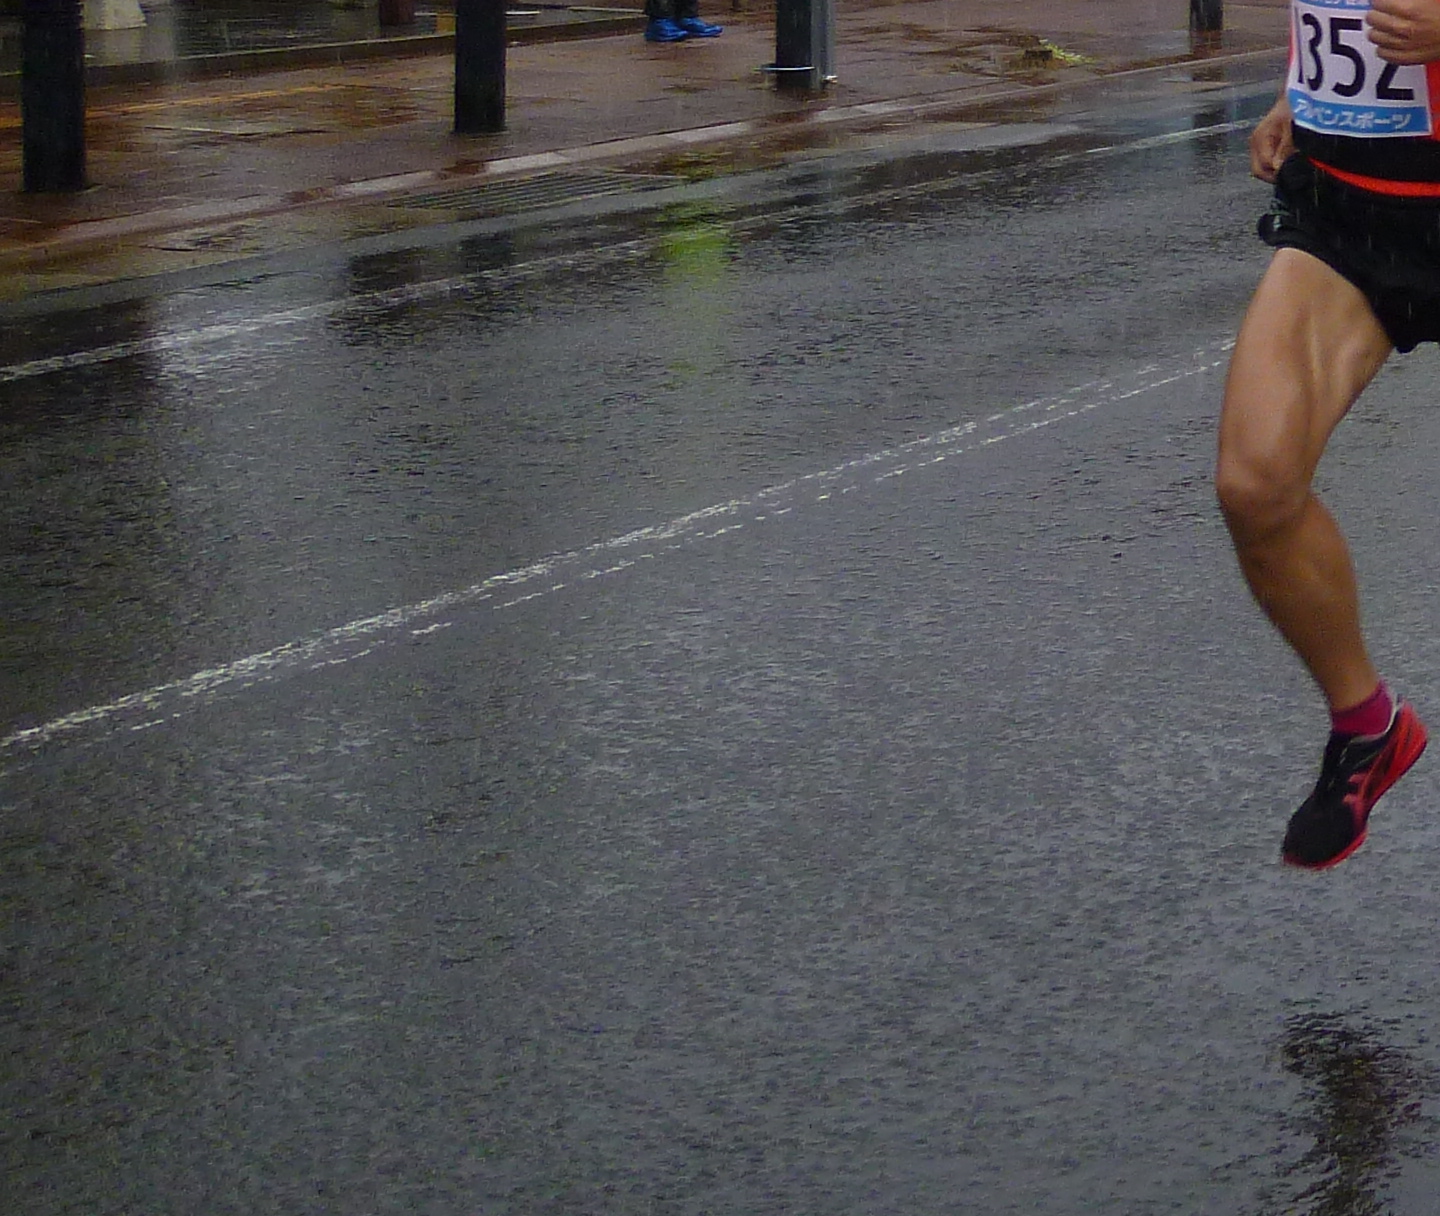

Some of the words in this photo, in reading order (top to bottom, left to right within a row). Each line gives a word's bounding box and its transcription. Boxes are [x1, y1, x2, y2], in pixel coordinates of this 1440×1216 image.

[1294, 98, 1412, 130] アルペンスポーツ
